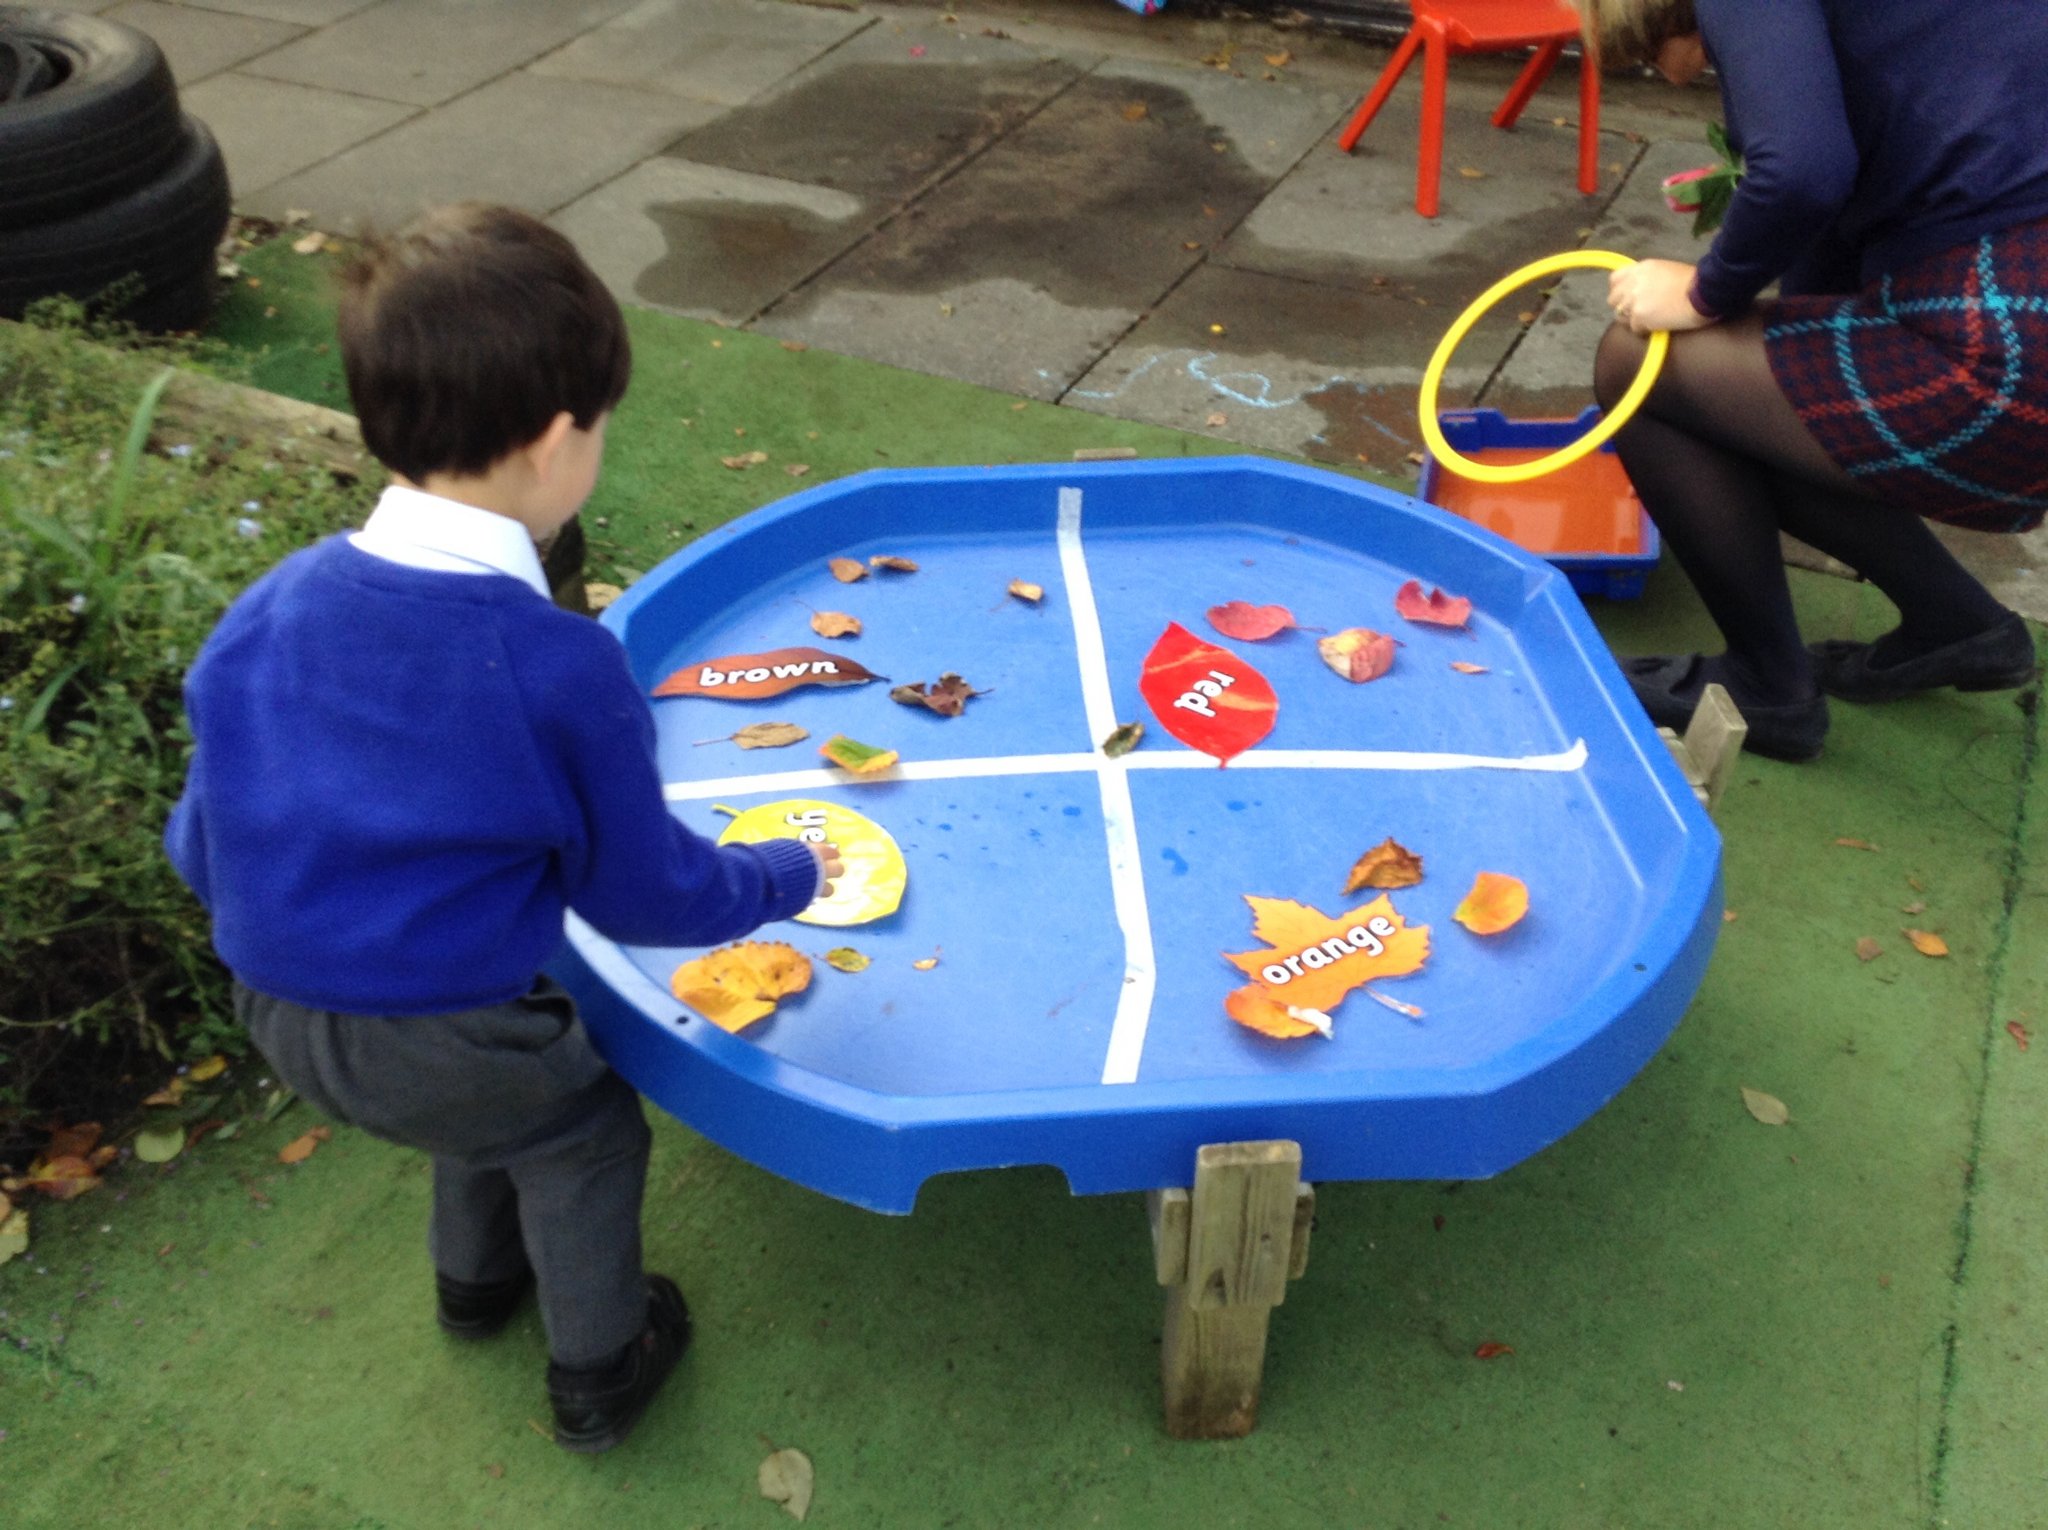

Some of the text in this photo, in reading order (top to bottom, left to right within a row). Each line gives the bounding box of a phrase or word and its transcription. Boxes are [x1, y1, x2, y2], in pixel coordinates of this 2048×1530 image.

[699, 660, 839, 687] brown
[1173, 670, 1236, 718] red
[1261, 916, 1396, 985] orange
